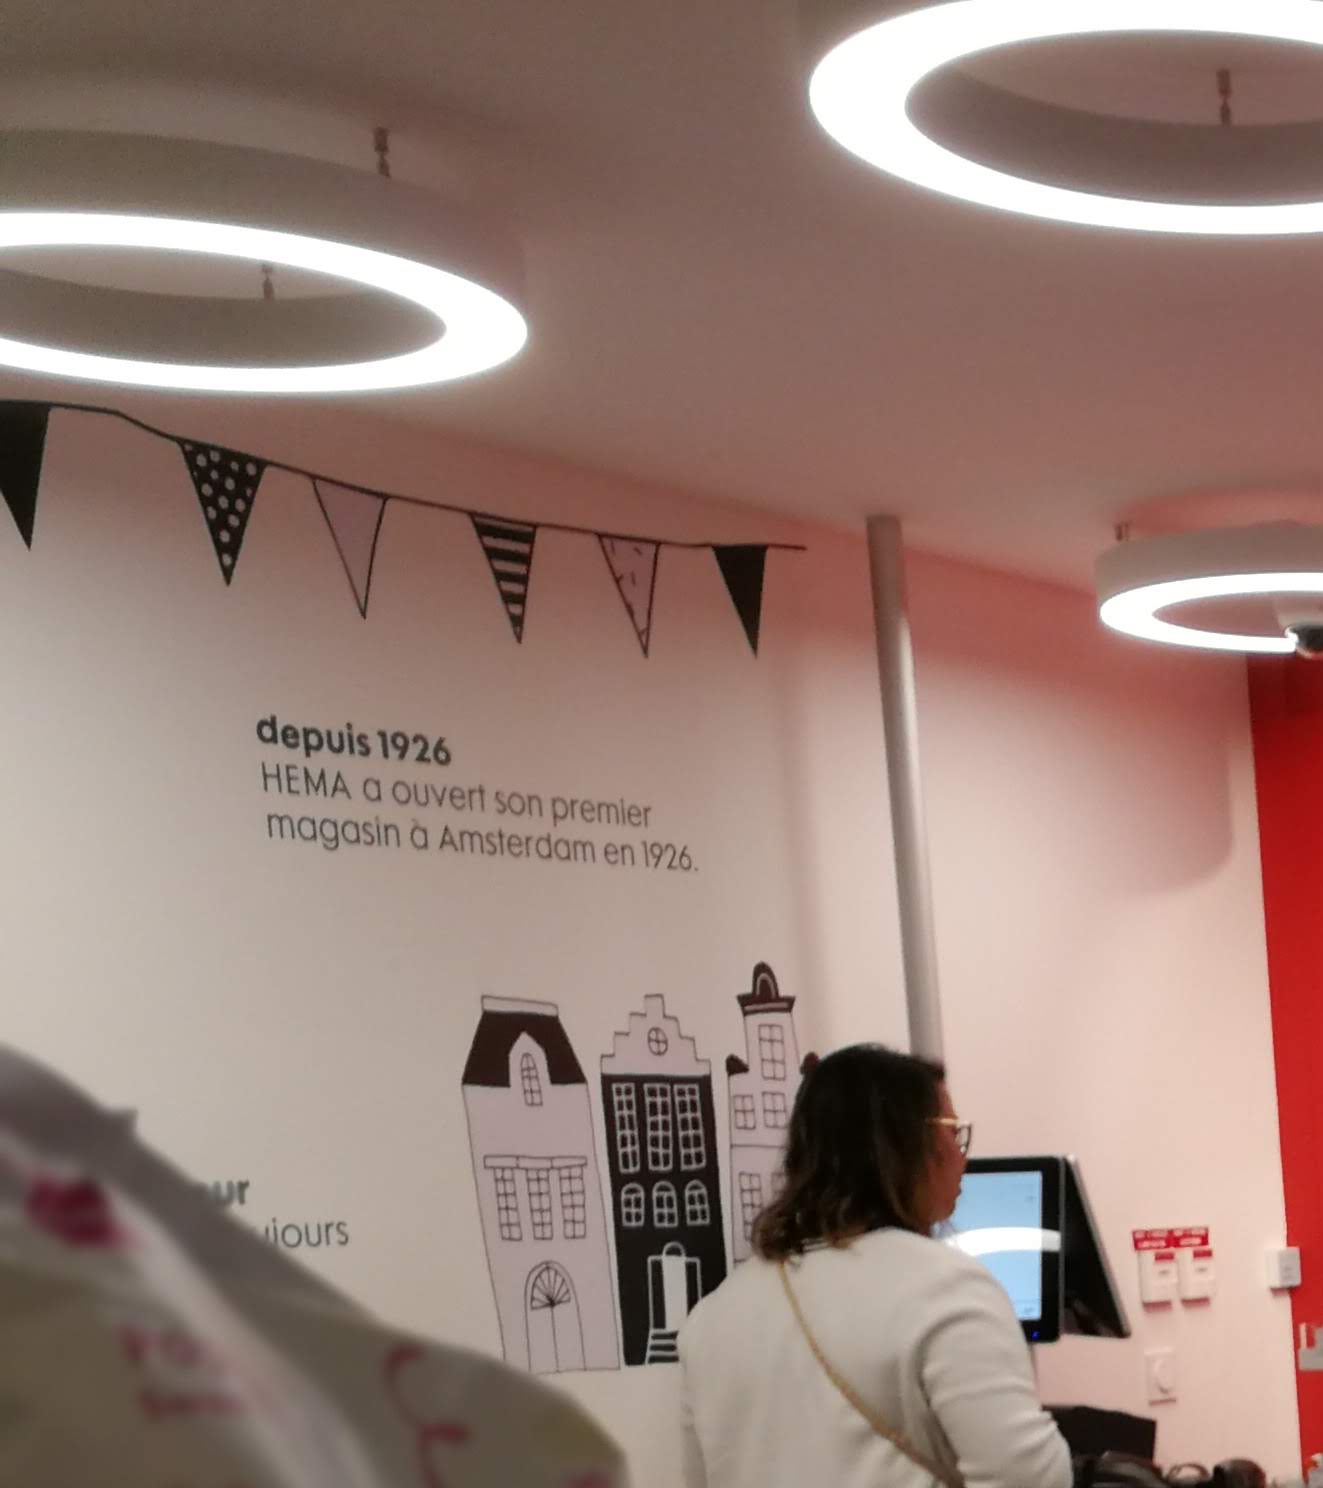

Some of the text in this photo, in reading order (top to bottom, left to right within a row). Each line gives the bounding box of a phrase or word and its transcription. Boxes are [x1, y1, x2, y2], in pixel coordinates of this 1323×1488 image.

[255, 715, 453, 766] depuis 1926
[261, 762, 653, 829] HEMA a ouvert son premier
[266, 811, 700, 873] magasin à Amsterdam en 1926.
